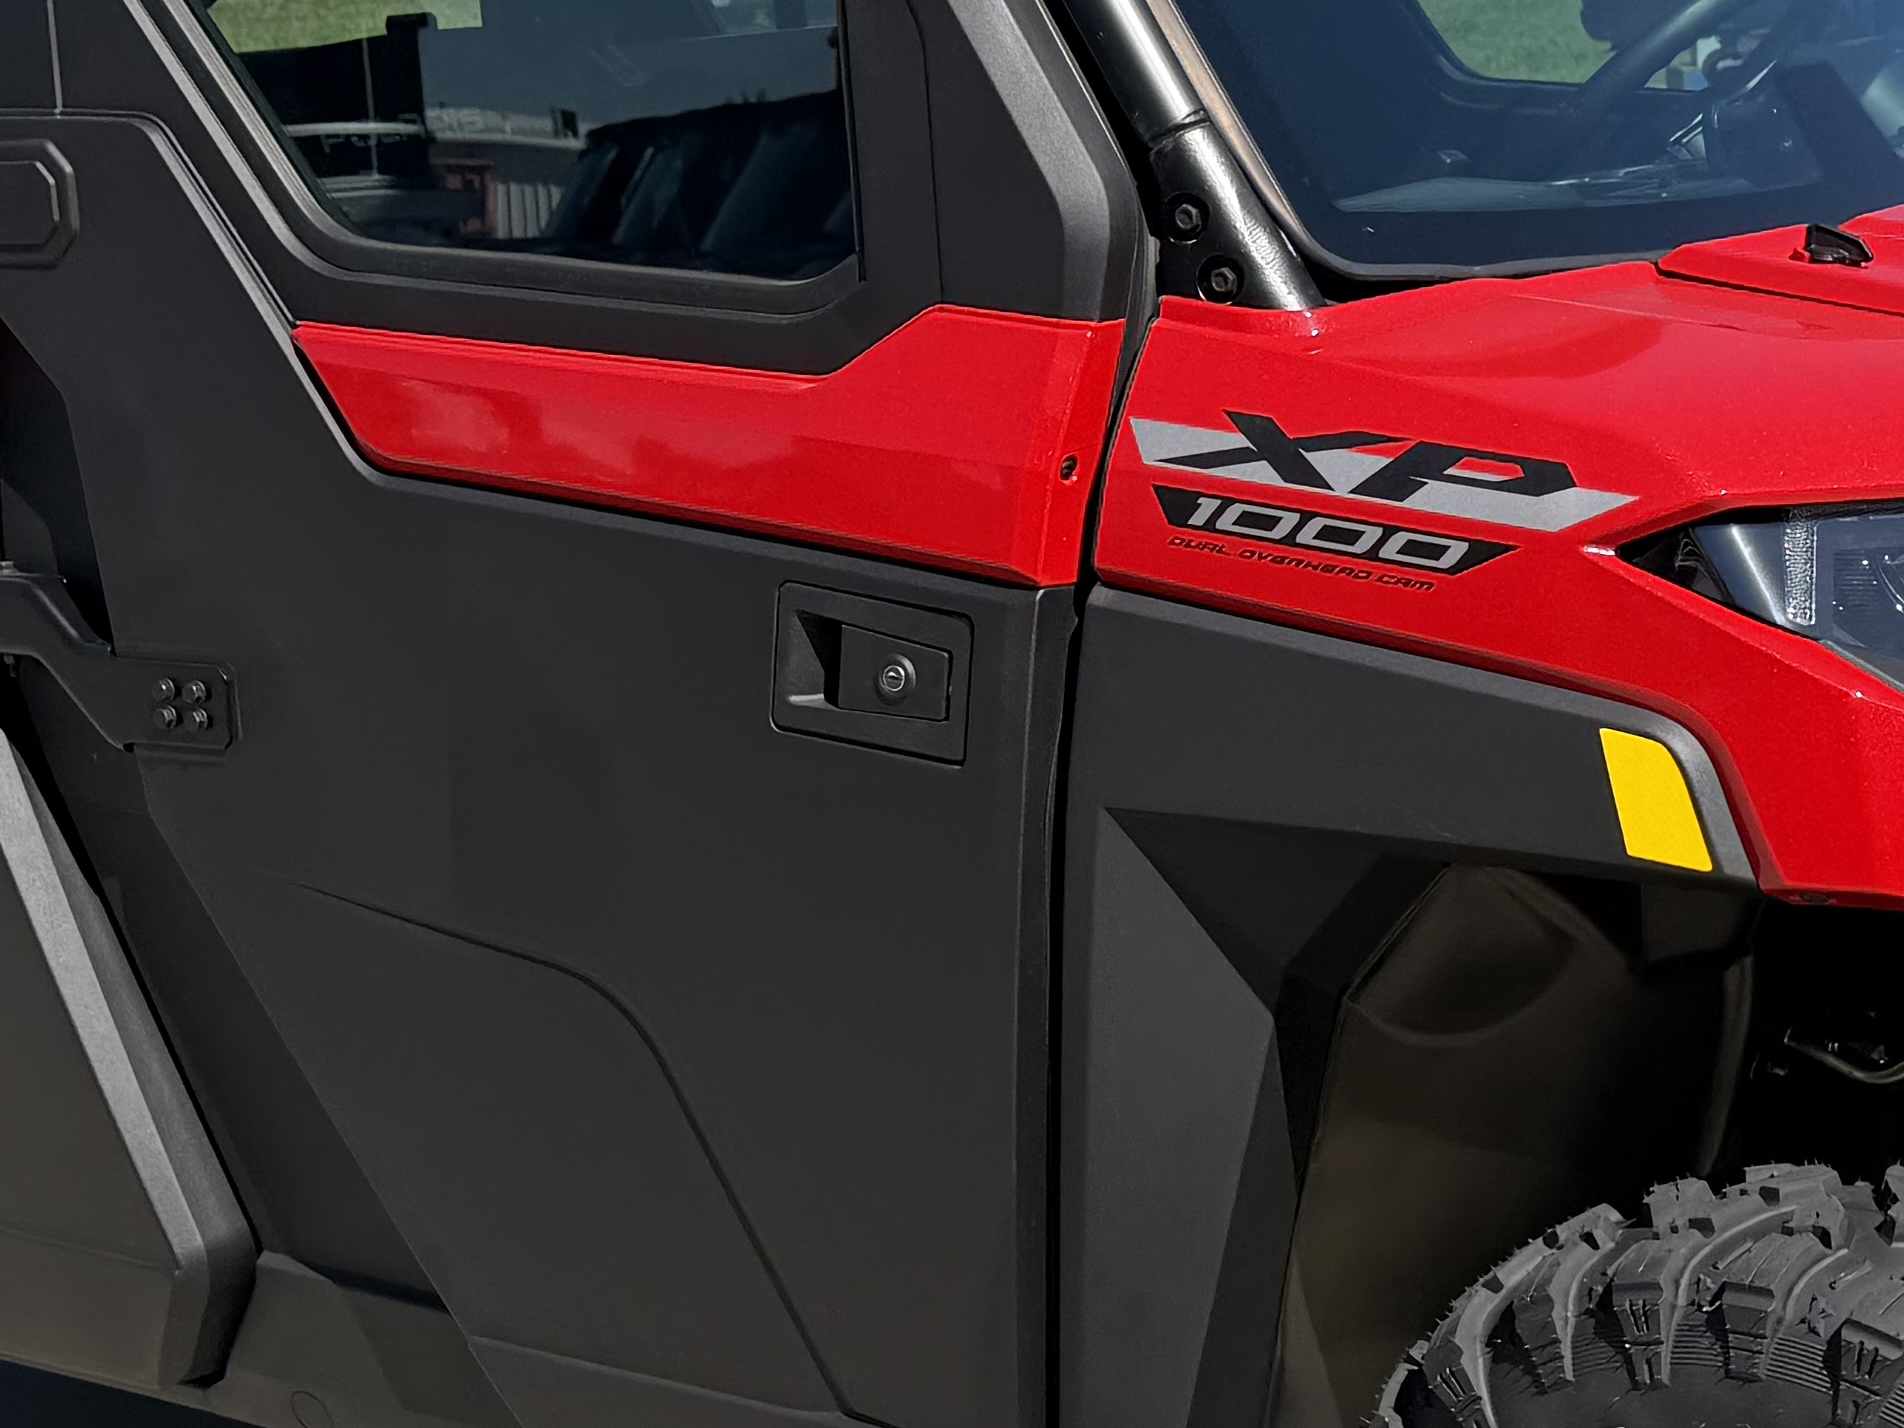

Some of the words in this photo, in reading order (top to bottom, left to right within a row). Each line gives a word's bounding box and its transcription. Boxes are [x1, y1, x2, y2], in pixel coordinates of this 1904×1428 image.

[1155, 409, 1579, 503] XP
[1167, 535, 1232, 558] DUAL
[1237, 548, 1374, 581] OVERHEAD
[1375, 572, 1436, 593] CAM
[1187, 494, 1471, 570] 1000
